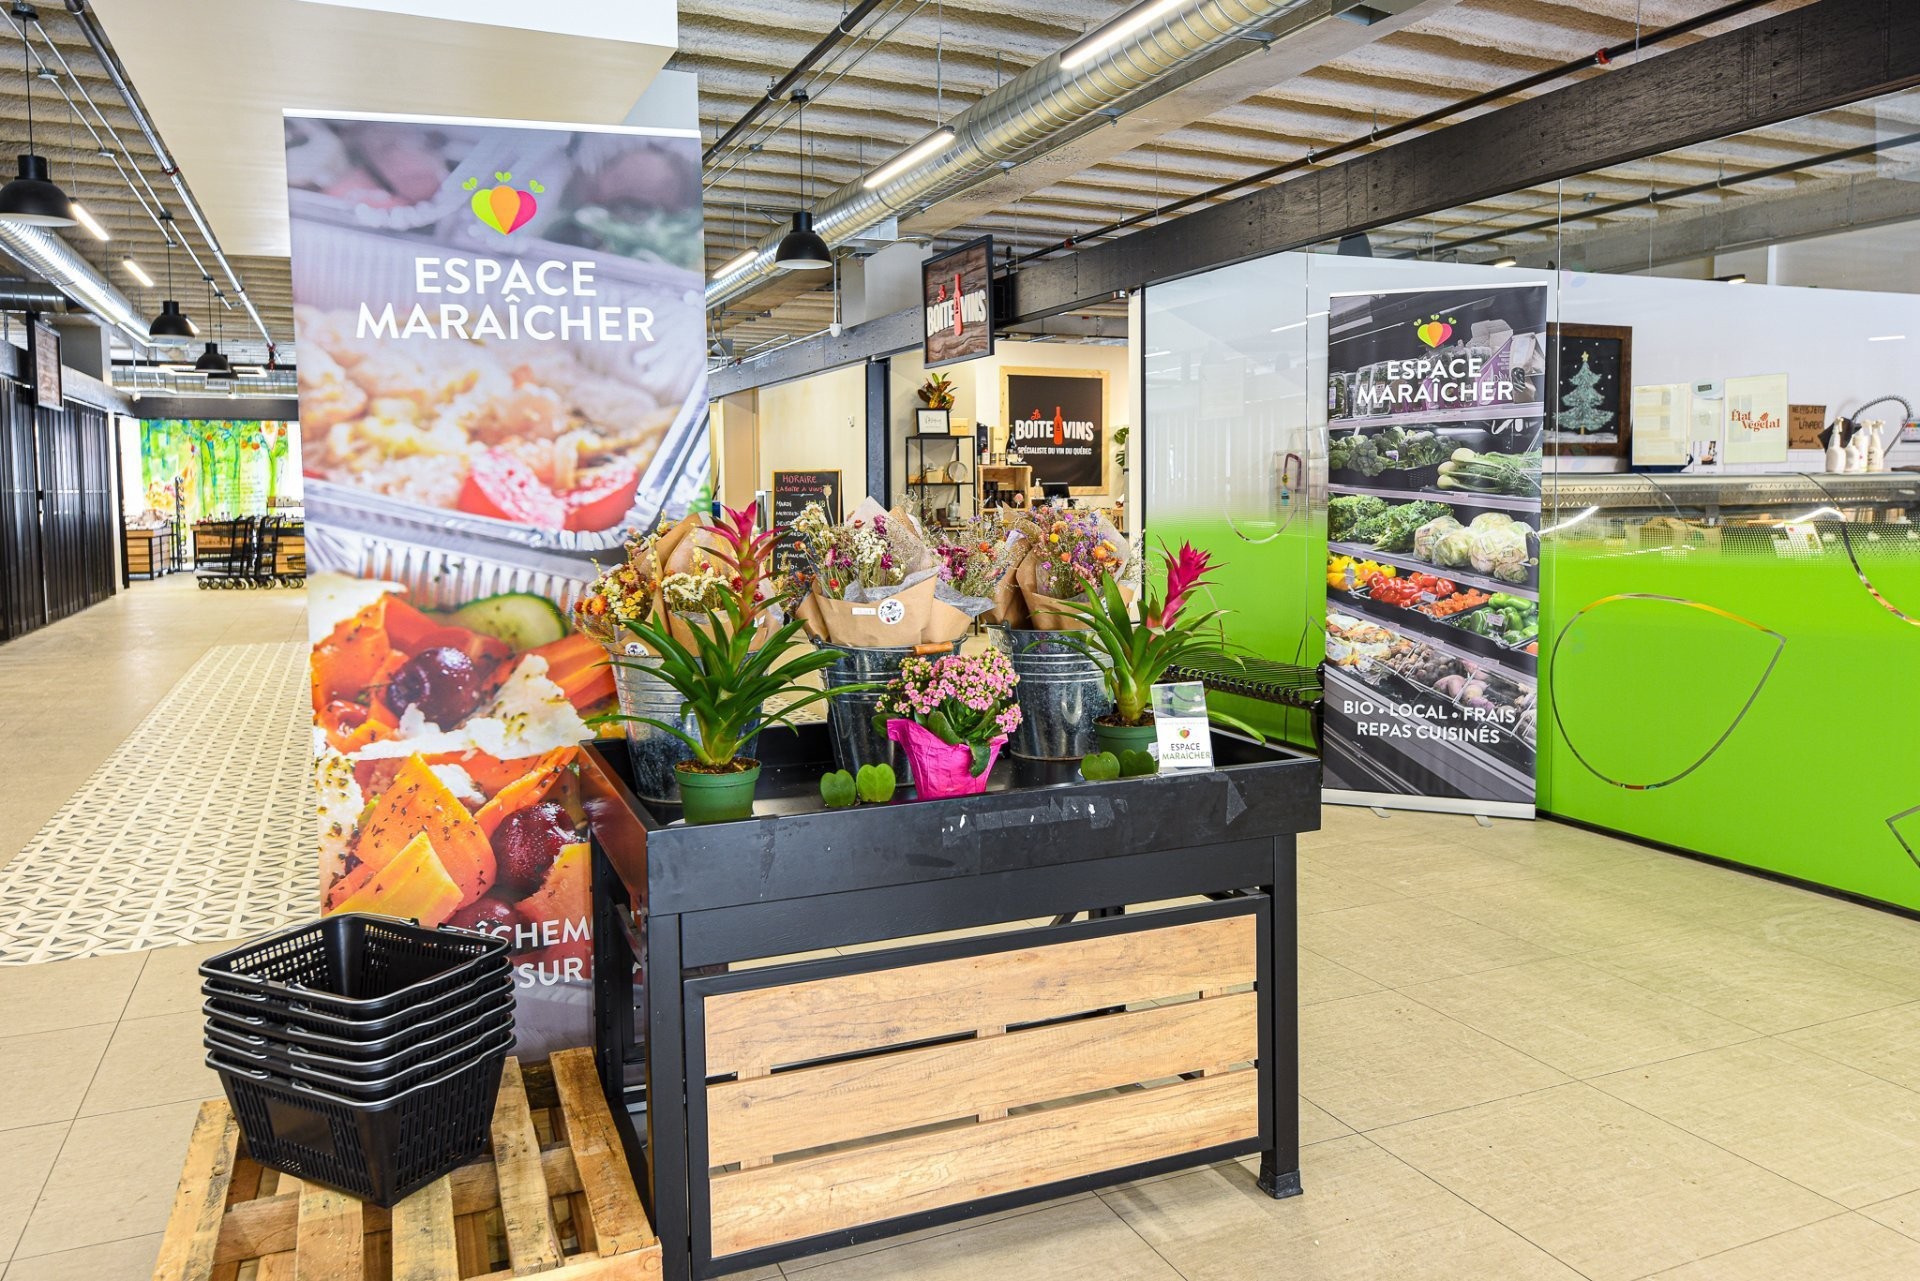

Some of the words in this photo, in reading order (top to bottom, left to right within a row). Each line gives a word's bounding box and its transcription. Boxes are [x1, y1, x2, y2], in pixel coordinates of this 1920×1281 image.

[415, 257, 597, 296] ESPACE
[356, 294, 655, 342] MARAÎCHER
[960, 289, 987, 323] VINS
[1387, 357, 1483, 381] ESPACE
[1356, 379, 1514, 404] MARAÎCHER
[1063, 420, 1094, 441] VINS
[1017, 445, 1047, 455] SPÉCIALISTE
[1047, 447, 1056, 455] DU
[1056, 447, 1065, 455] VIN
[1065, 447, 1073, 455] DU
[1073, 446, 1093, 456] QUÉBEC
[1343, 700, 1374, 715] BIO
[1390, 702, 1448, 720] LOCAL
[1463, 707, 1516, 724] FRAIS
[1357, 721, 1412, 739] REPAS
[1416, 725, 1500, 744] CUISINÉS
[1171, 742, 1201, 751] ESPACE
[518, 957, 584, 989] SUR
